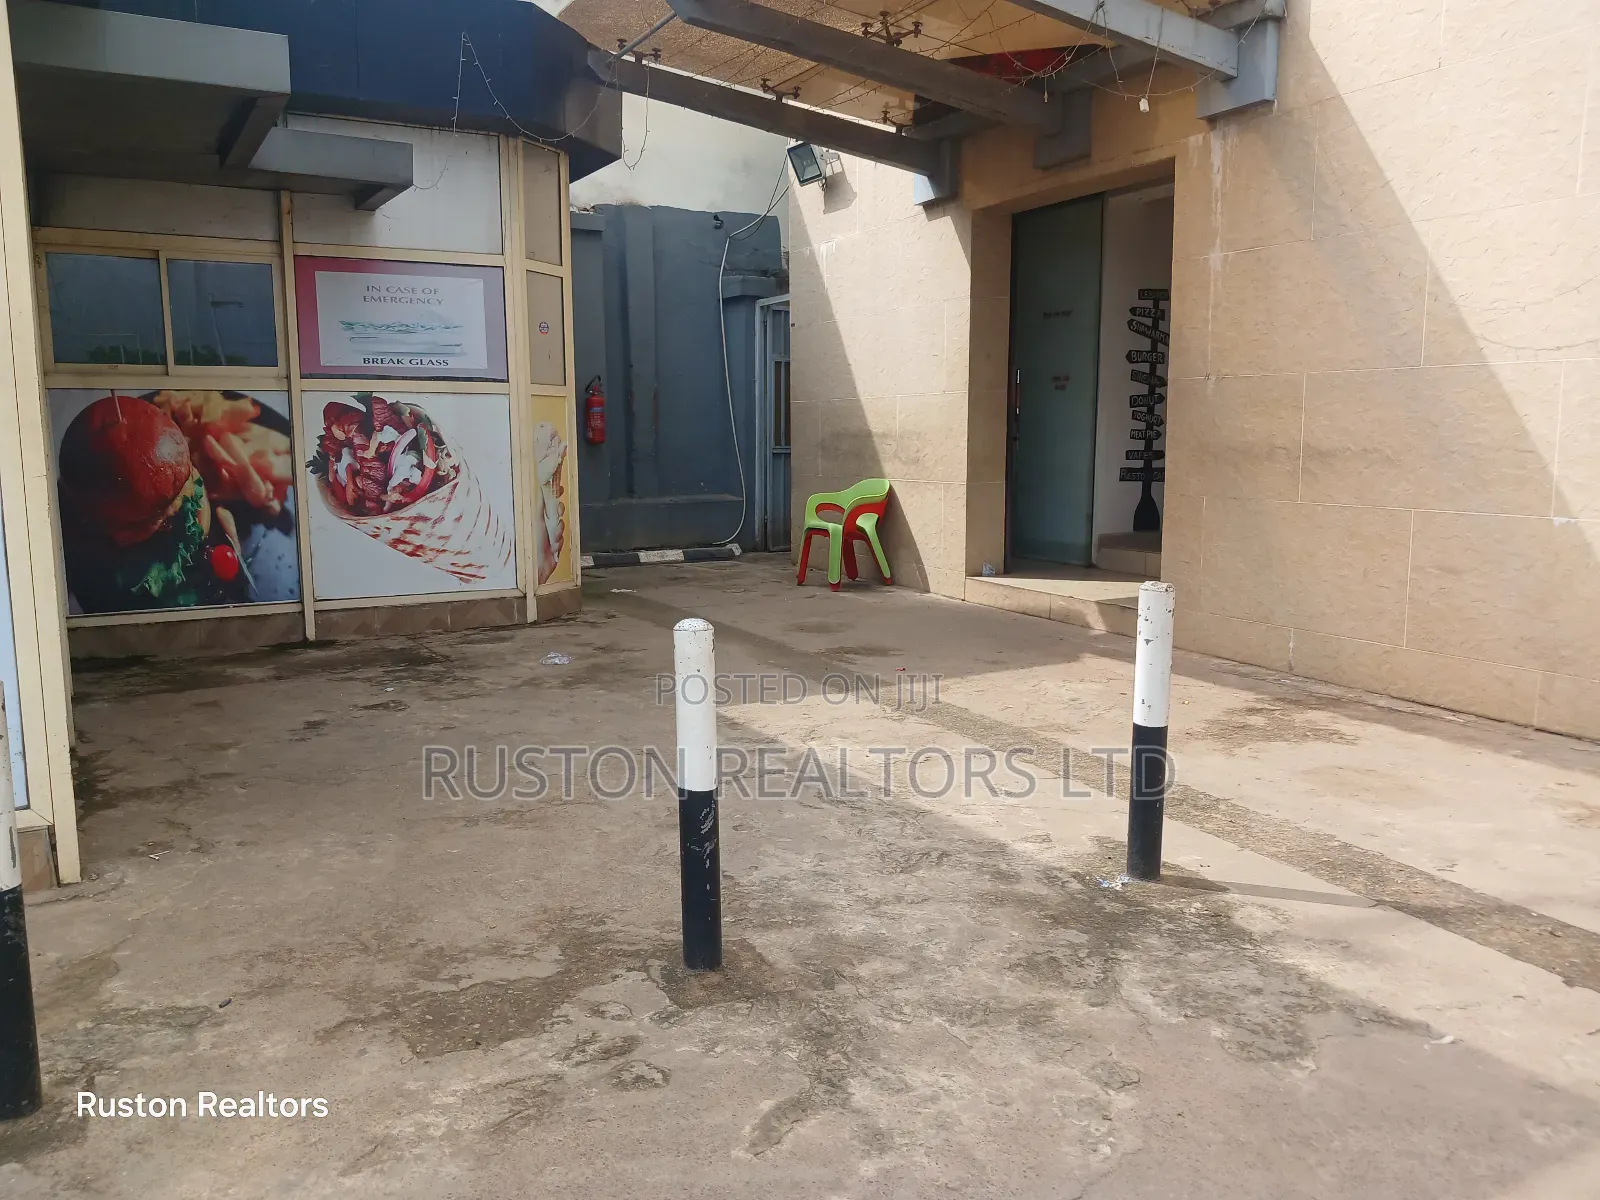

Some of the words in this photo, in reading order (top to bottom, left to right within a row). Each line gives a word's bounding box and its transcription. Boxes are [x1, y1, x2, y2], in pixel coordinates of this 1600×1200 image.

[366, 285, 381, 293] IN
[386, 286, 418, 294] CASE
[363, 295, 444, 306] EMERGENCY
[1136, 307, 1161, 318] PIZZA
[363, 357, 404, 365] BREAK
[409, 358, 449, 366] GLASS
[1131, 351, 1163, 364] BURGER
[1131, 394, 1159, 406] DONUT
[1133, 411, 1161, 425] YOGHURT
[1130, 430, 1145, 438] MEAT
[1147, 430, 1158, 438] PIE
